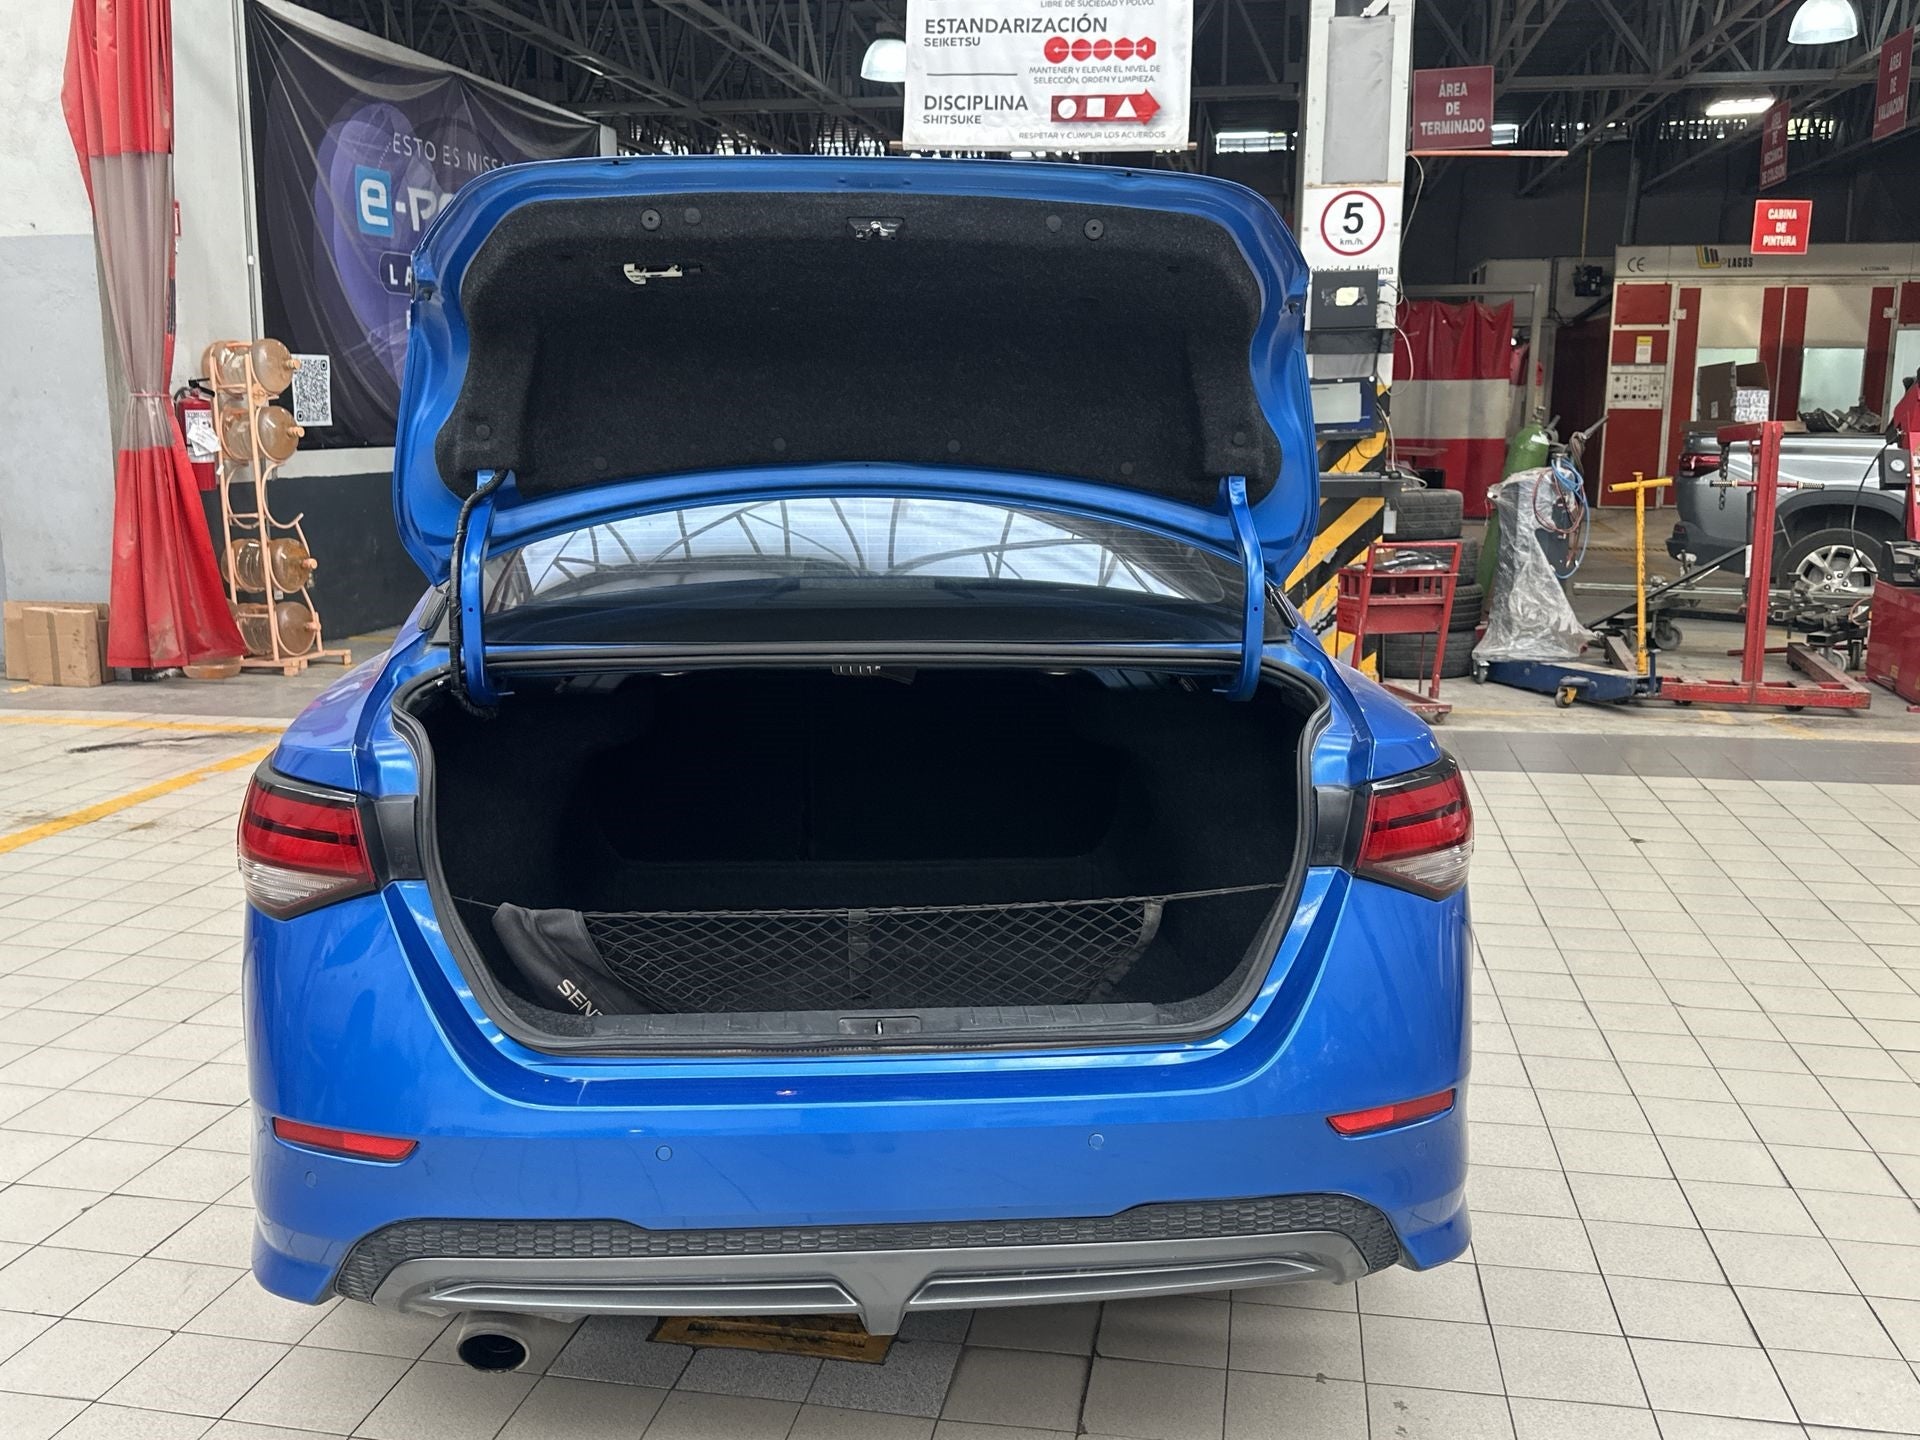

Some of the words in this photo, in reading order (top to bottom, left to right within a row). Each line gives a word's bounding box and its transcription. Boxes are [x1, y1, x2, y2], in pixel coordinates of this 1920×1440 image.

[1040, 0, 1063, 8] LIBRE
[1064, 0, 1076, 8] DE
[1077, 0, 1118, 8] SUCIEDAD
[925, 13, 1107, 34] ESTANDARIZACIÓN
[924, 37, 981, 47] SEIKETSU
[1029, 66, 1074, 75] MANTENER
[1075, 66, 1080, 74] Y
[1082, 65, 1112, 74] ELEVAR
[1114, 65, 1125, 73] EL
[1125, 64, 1148, 73] NIVEL
[1150, 64, 1161, 73] DE
[1081, 75, 1110, 84] ORDEN
[1111, 75, 1117, 83] Y
[1438, 80, 1468, 98] ÁREA
[924, 94, 1029, 111] DISCIPLINA
[1445, 101, 1460, 116] DE
[923, 115, 982, 125] SHITSUKE
[1420, 118, 1485, 136] TERMINADO
[1066, 131, 1102, 139] CUMPLIR
[1104, 131, 1120, 139] LOS
[1121, 131, 1166, 139] ACUERDOS
[393, 132, 436, 162] ESTO
[443, 145, 460, 169] ES
[1342, 202, 1363, 234] 5
[1767, 208, 1797, 220] CABINA
[1775, 221, 1787, 233] DE
[1762, 235, 1797, 247] PINTURA
[557, 979, 603, 1017] SEN
